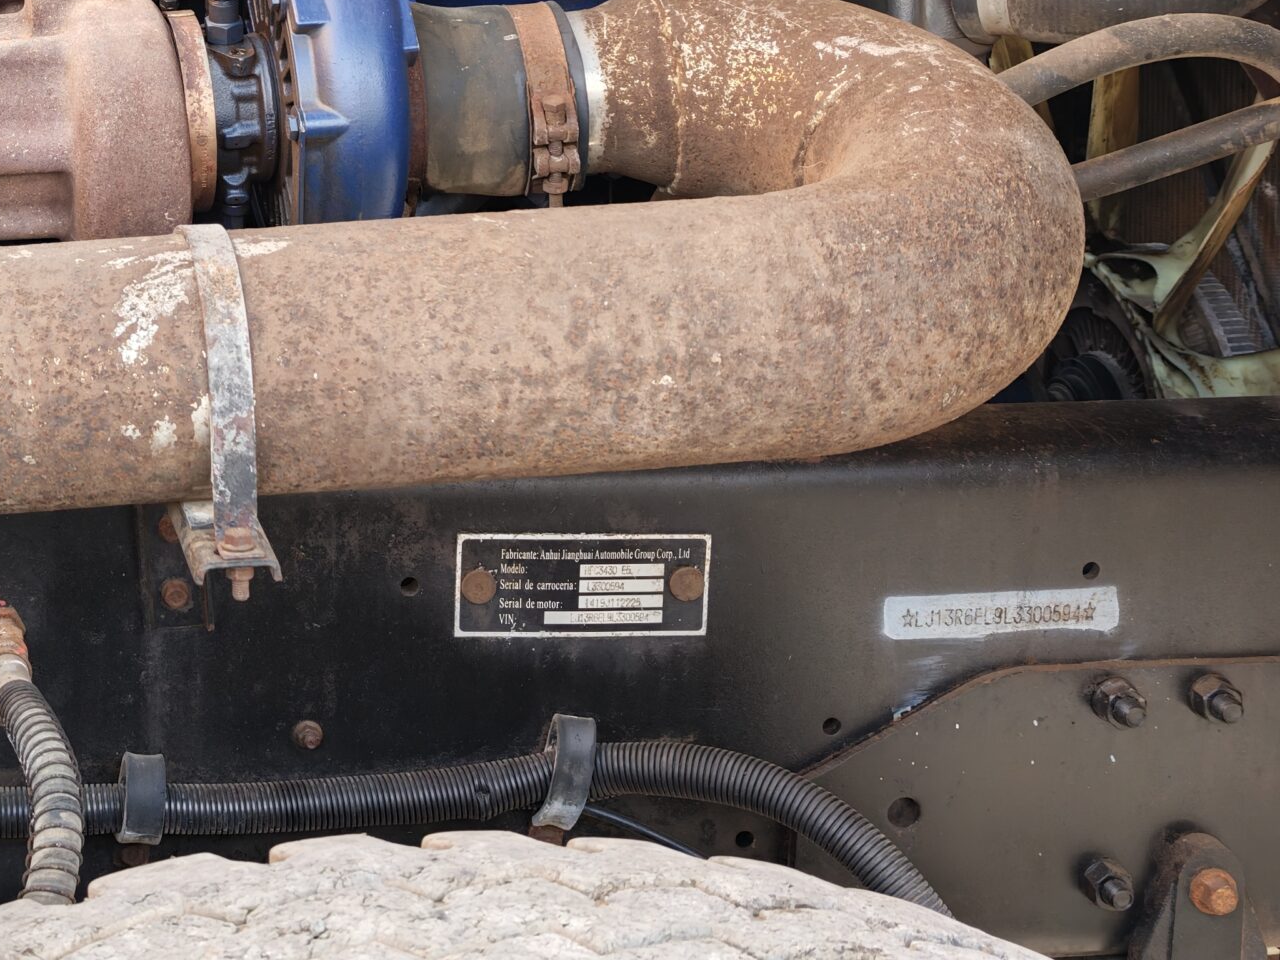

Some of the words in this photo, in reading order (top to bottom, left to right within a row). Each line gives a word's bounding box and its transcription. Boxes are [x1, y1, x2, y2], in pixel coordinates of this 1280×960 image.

[501, 548, 539, 560] Fabricante:
[540, 548, 561, 560] Anhui
[562, 549, 594, 563] Jianghuai
[595, 548, 634, 560] Automobile
[634, 548, 656, 562] Group
[500, 563, 528, 575] Modelo:
[499, 579, 522, 590] Serial
[524, 580, 534, 590] de
[536, 580, 577, 591] carroceria:
[499, 597, 523, 609] Serial
[525, 598, 535, 609] de
[536, 599, 563, 609] motor:
[498, 613, 517, 625] VIN:
